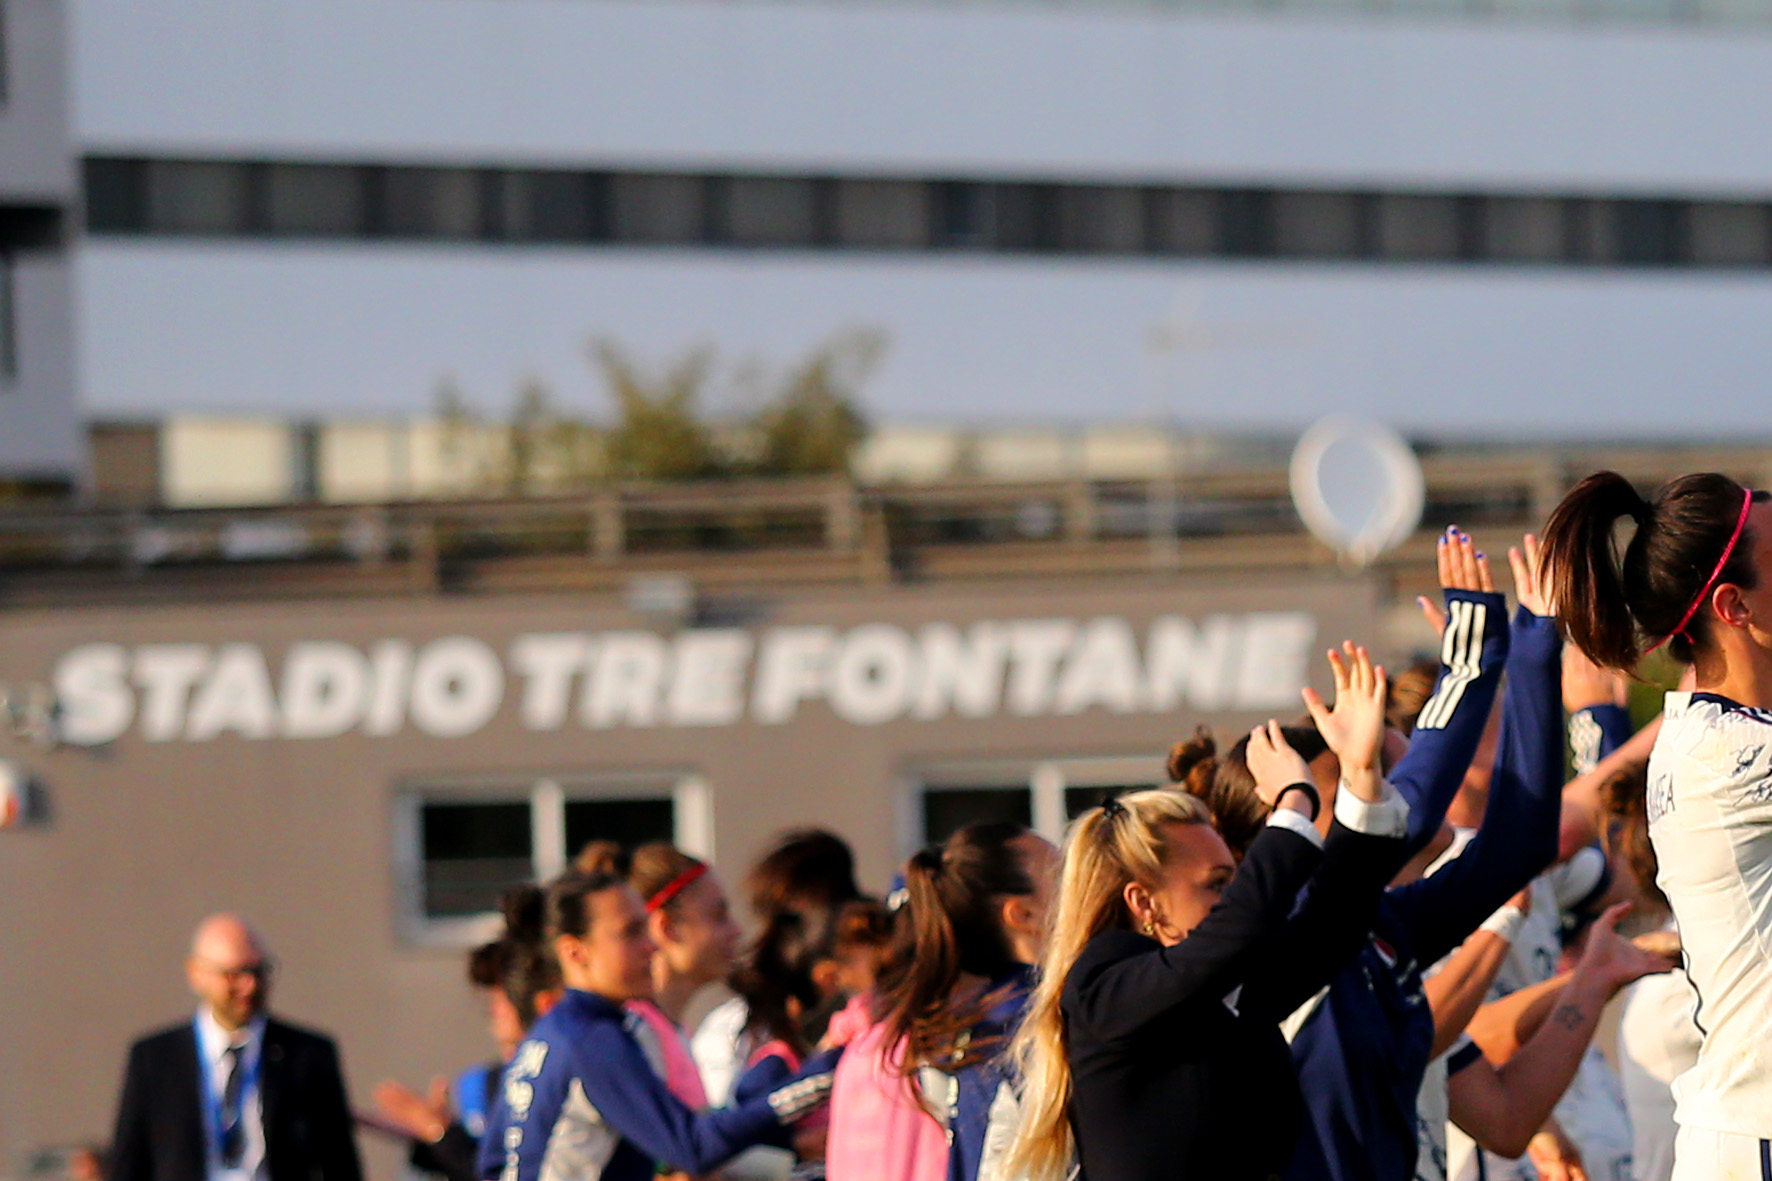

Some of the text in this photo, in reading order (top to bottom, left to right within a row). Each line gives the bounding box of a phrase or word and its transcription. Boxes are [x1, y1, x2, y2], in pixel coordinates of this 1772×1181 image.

[56, 611, 1314, 743] STADIO TRE FONTANE
